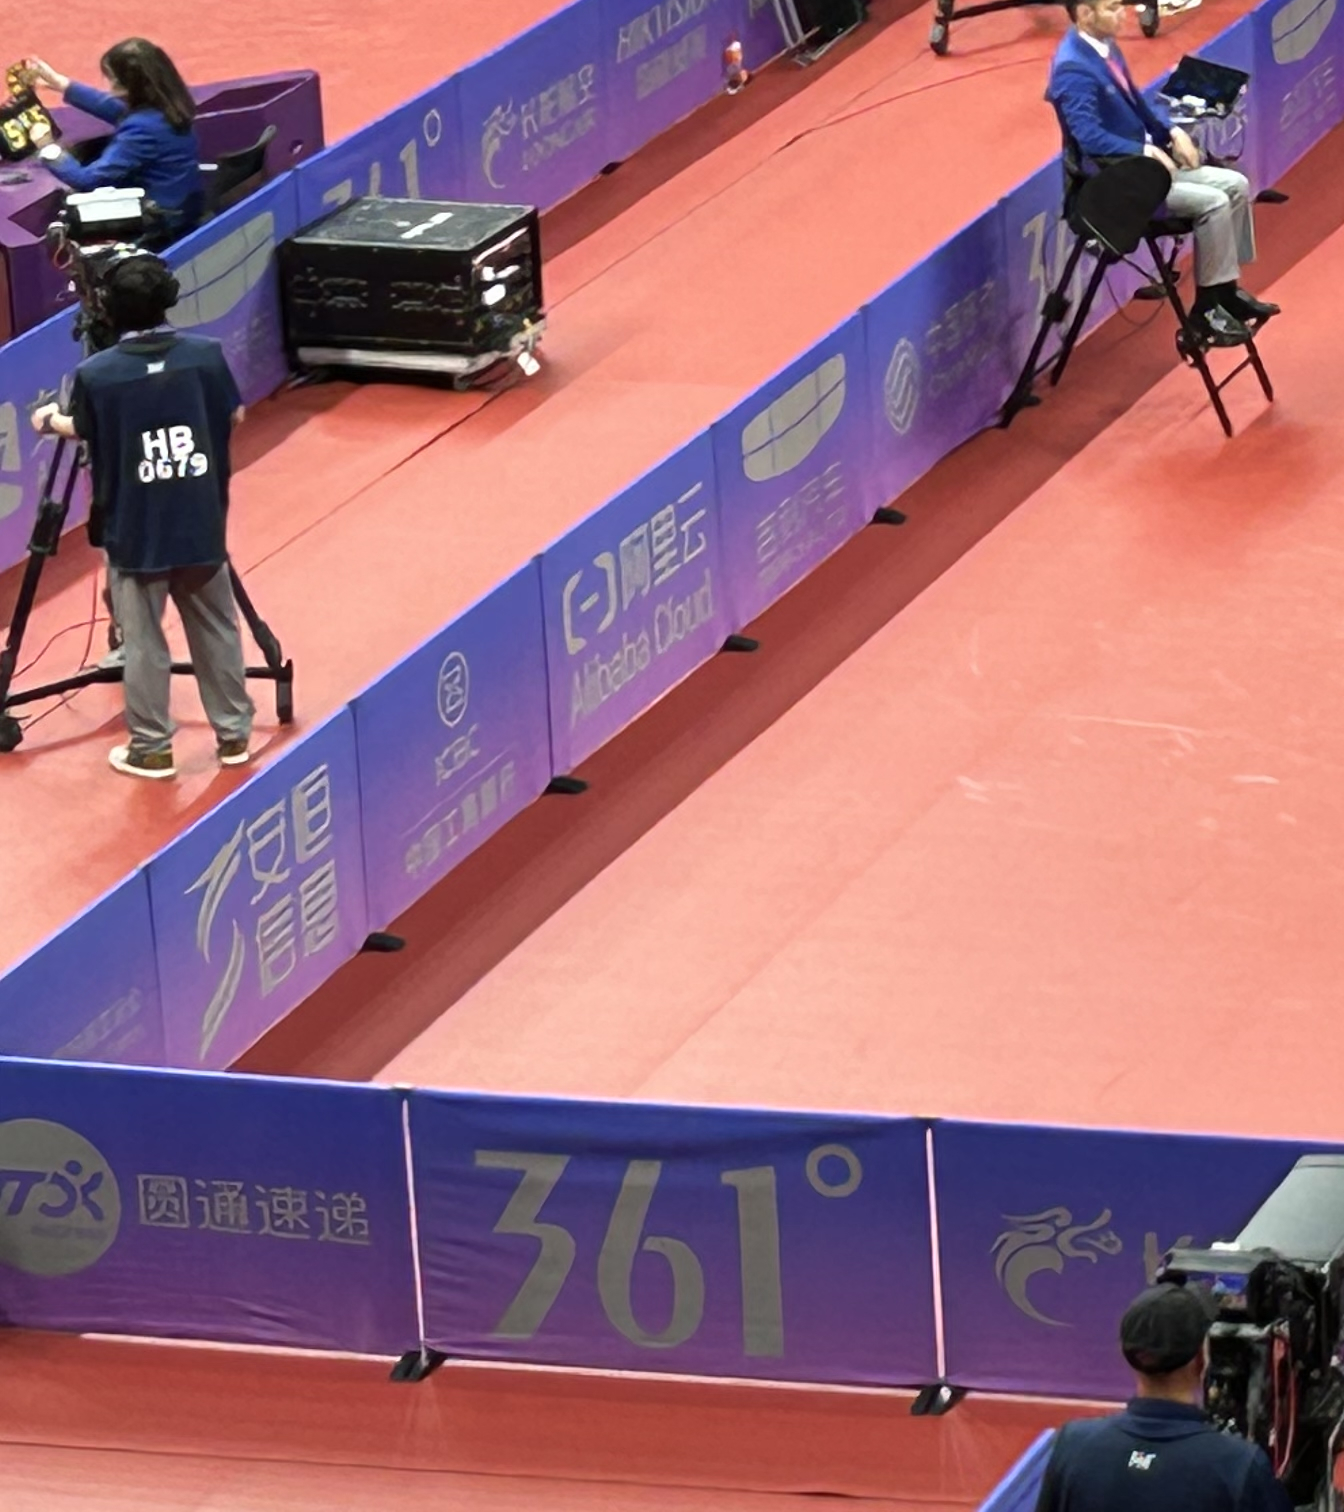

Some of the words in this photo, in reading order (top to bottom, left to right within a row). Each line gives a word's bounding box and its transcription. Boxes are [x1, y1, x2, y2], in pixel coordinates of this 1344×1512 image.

[141, 425, 195, 459] HB
[137, 1173, 372, 1245] 圆通速递
